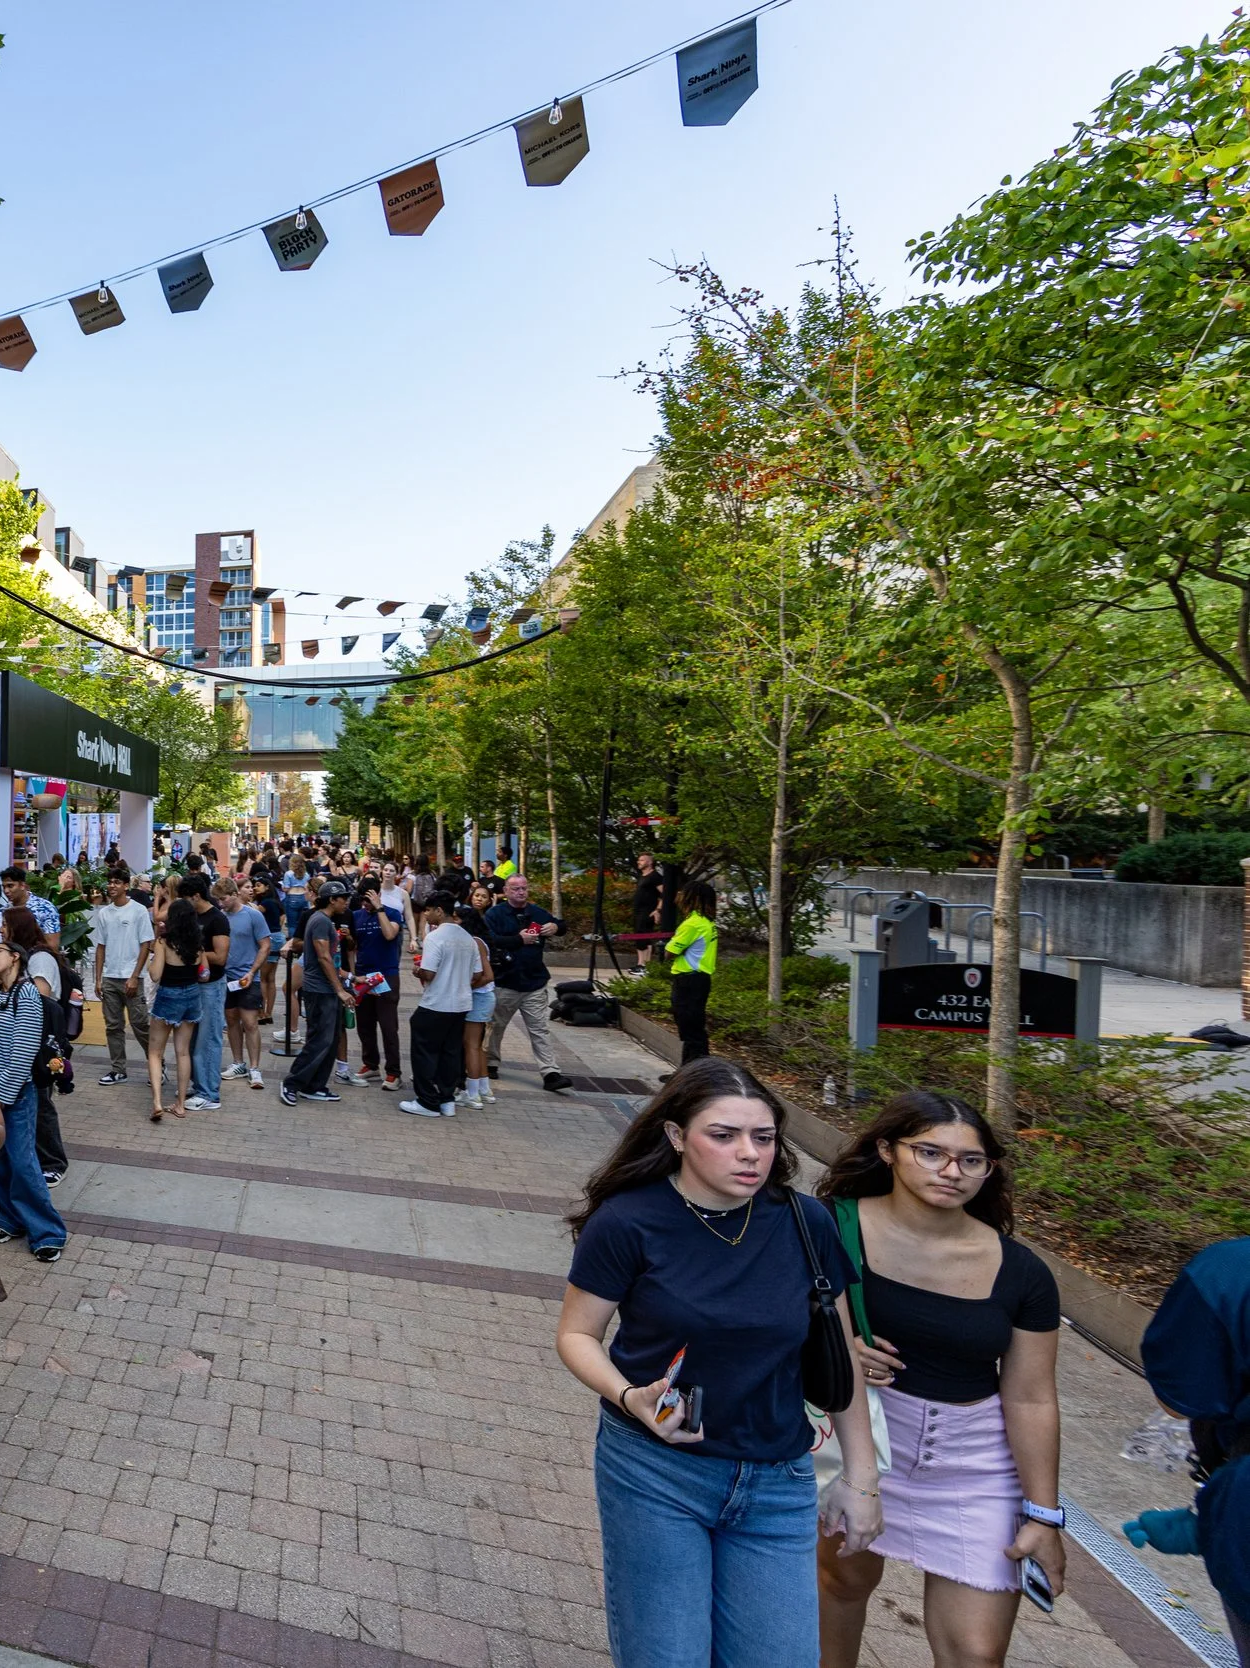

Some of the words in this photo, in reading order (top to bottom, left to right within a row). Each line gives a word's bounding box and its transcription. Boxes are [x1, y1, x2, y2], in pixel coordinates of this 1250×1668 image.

[524, 135, 558, 155] MICHAEL
[559, 122, 581, 138] KORS
[387, 181, 435, 207] GATORADE
[277, 226, 315, 251] BLOCK
[281, 234, 318, 261] PARTY
[937, 994, 968, 1007] 432
[914, 1008, 983, 1023] CAMPUS
